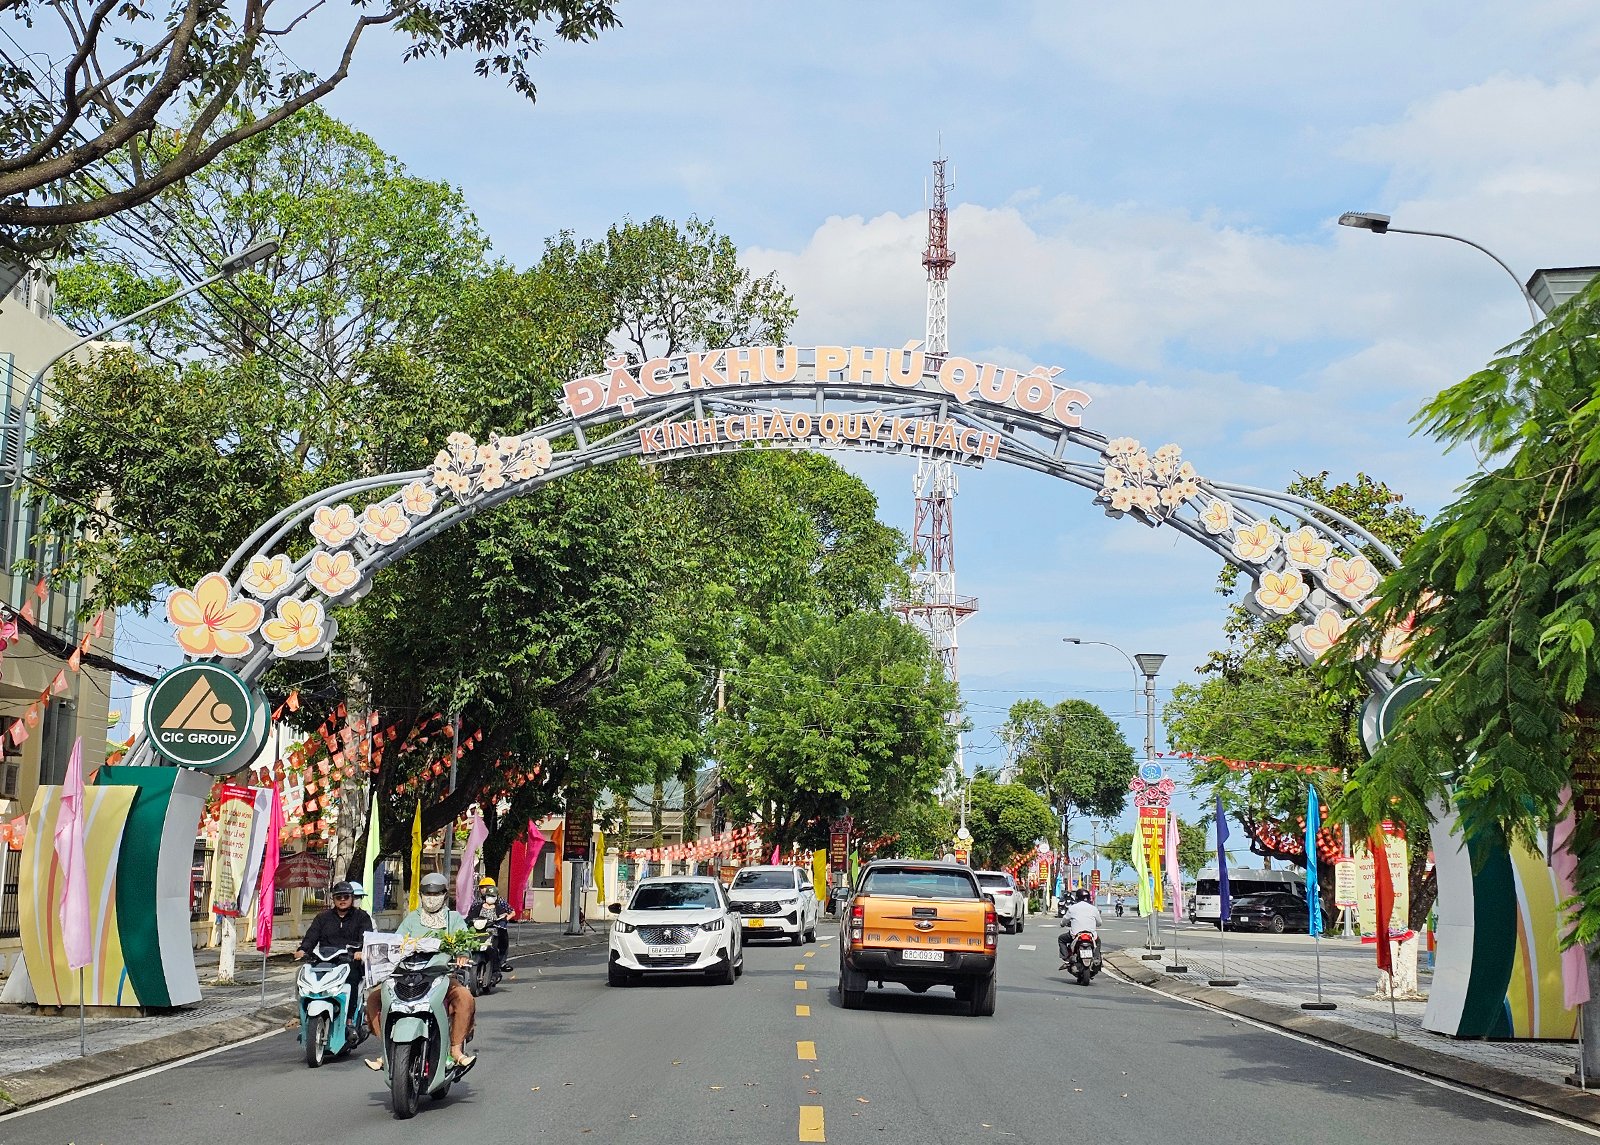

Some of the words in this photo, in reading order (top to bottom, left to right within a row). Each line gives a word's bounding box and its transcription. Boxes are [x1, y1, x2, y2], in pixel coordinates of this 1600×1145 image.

[562, 355, 676, 418] ĐẶC
[687, 346, 798, 389] KHU
[814, 340, 925, 387] PHÚ
[938, 356, 1092, 429] QUỐC
[639, 417, 719, 455] KÍNH
[724, 408, 813, 442] CHÀO
[823, 410, 884, 446] QUÝ
[890, 416, 1002, 459] KHÁCH
[161, 732, 184, 743] CIC
[188, 733, 237, 745] GROUP
[866, 933, 982, 946] RANGER
